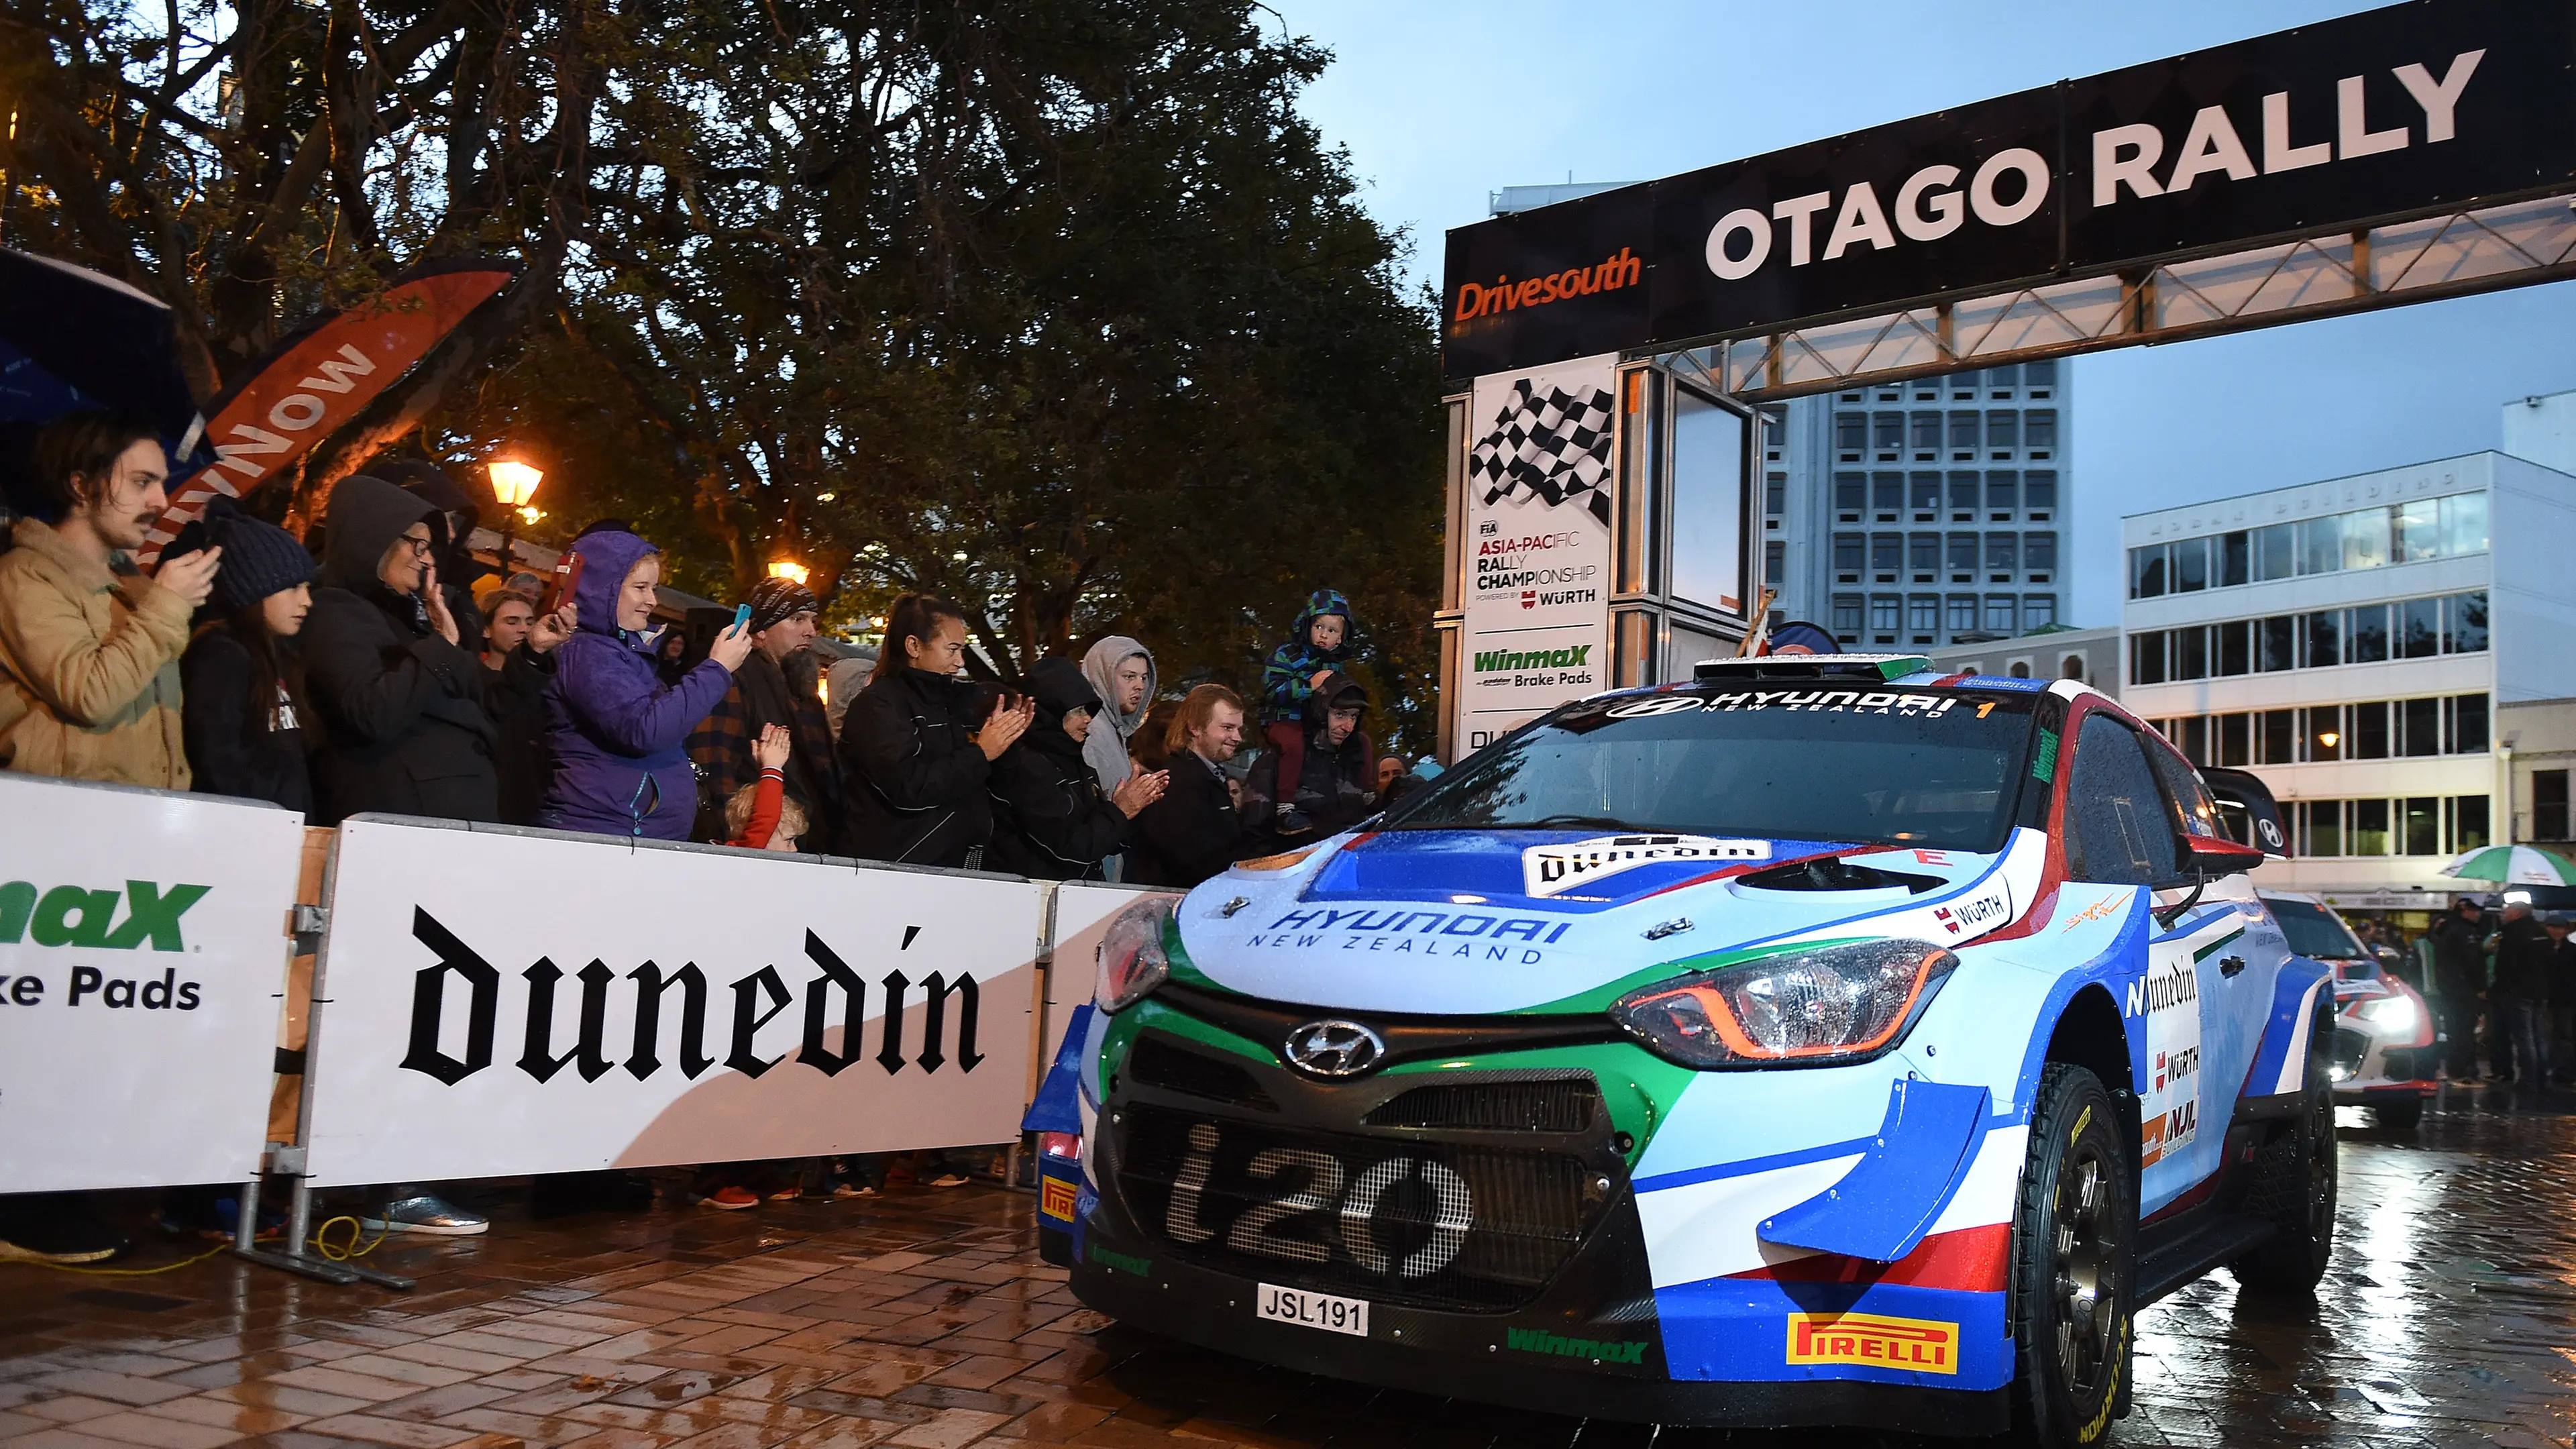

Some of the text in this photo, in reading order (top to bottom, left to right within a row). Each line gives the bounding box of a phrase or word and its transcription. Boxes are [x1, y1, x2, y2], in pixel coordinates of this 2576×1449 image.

[1705, 48, 2487, 280] OTAGO RALLY
[1454, 246, 1642, 322] Drivesouth
[1478, 531, 1580, 556] ASIA-PACIFIC
[1477, 554, 1527, 573] RALLY
[1477, 565, 1597, 590] CHAMPIONSHIP
[1476, 592, 1508, 602] POWERED
[1515, 674, 1554, 687] Brake
[1559, 671, 1592, 684] Pads
[1701, 704, 1943, 718] NEW ZEALAND
[1711, 691, 1994, 718] HYUNDAI 1
[1268, 910, 1572, 944] HYUNDAI
[1246, 934, 1542, 965] NEW ZEALAND
[68, 965, 201, 1011] Pads
[2125, 975, 2146, 1018] N
[2162, 1130, 2195, 1158] BUILDING
[1166, 1124, 1474, 1277] i20
[1265, 1290, 1361, 1331] JSL191
[1796, 1322, 1949, 1364] PIRELLI
[2079, 1313, 2128, 1444] SCORPION
